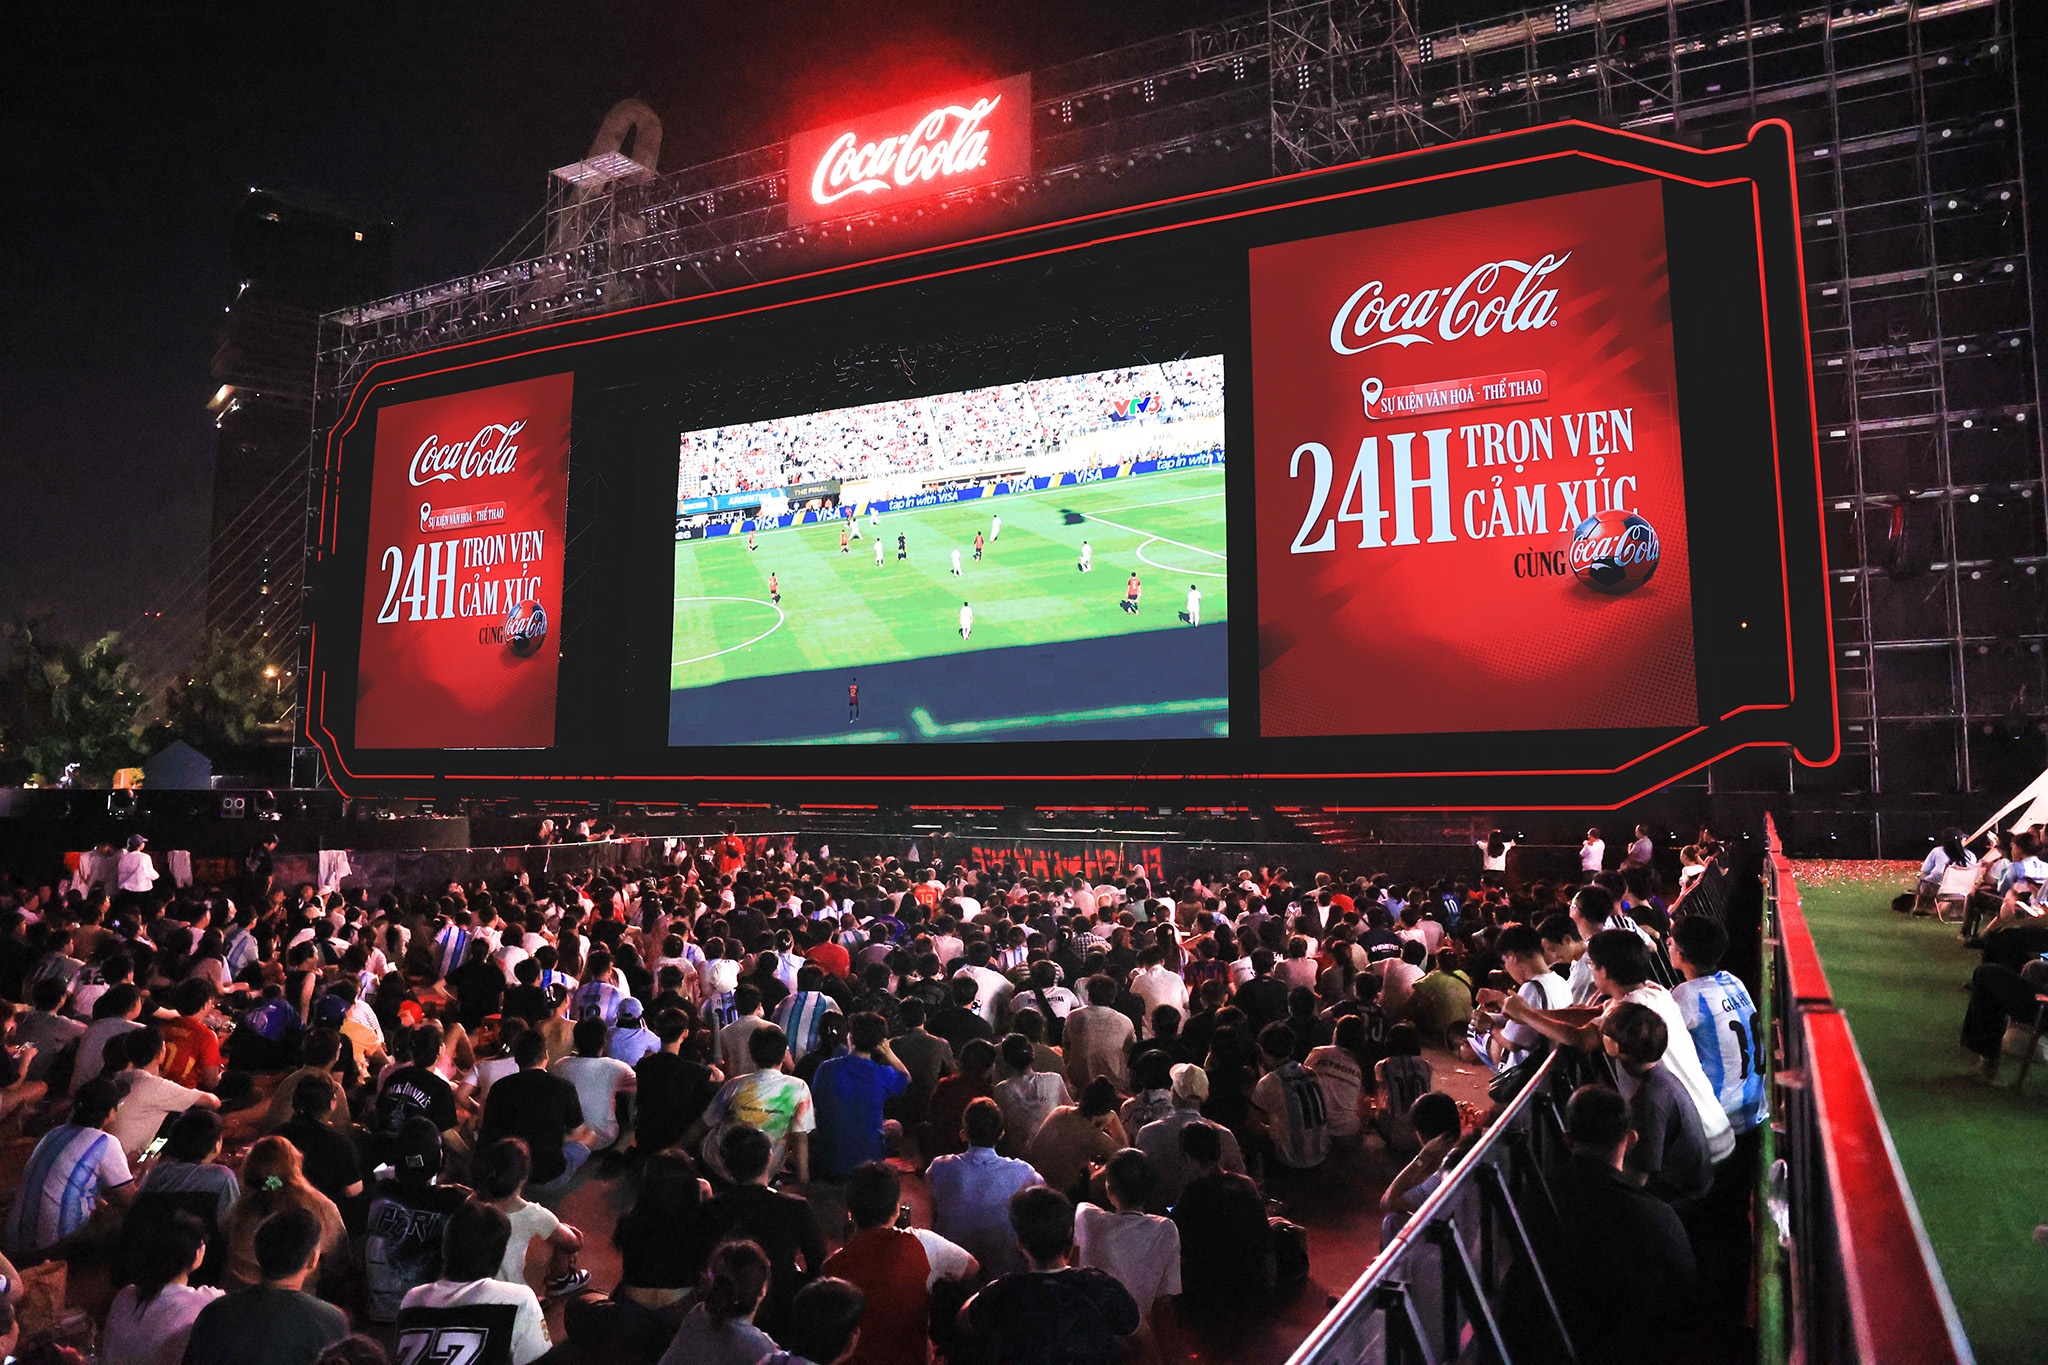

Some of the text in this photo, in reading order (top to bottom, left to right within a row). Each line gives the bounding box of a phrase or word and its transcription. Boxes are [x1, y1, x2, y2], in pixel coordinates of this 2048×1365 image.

[812, 94, 1001, 204] Coca-Cola
[1330, 251, 1572, 355] Coca-Cola
[1113, 396, 1161, 417] VTV3
[1381, 390, 1396, 415] SỰ
[1397, 391, 1424, 412] KIỆN
[1425, 389, 1449, 407] VĂN
[1450, 384, 1475, 404] HOÁ
[1483, 378, 1507, 400] THỂ
[1508, 379, 1542, 397] THAO
[408, 419, 528, 486] Coca-Cola
[1460, 408, 1635, 473] TRỌN VẸN
[1075, 469, 1103, 485] VISA
[1157, 459, 1175, 470] tap
[1188, 451, 1214, 466] with
[794, 485, 828, 497] THE FINAL
[889, 500, 905, 511] tap
[916, 494, 937, 506] with
[937, 491, 959, 503] VISA
[1008, 479, 1035, 493] VISA
[1289, 428, 1457, 554] 24H
[1463, 466, 1638, 540] CẢM XÚC
[488, 508, 504, 520] THAO
[753, 516, 780, 530] VISA
[815, 505, 841, 521] VISA
[463, 530, 544, 573] TRỌN VẸN
[1514, 547, 1566, 578] CÙNG
[377, 539, 460, 623] 24H
[459, 573, 499, 617] CẢM
[479, 623, 504, 645] CÙNG
[1729, 1012, 1766, 1079] 10
[398, 1326, 489, 1365] 77
